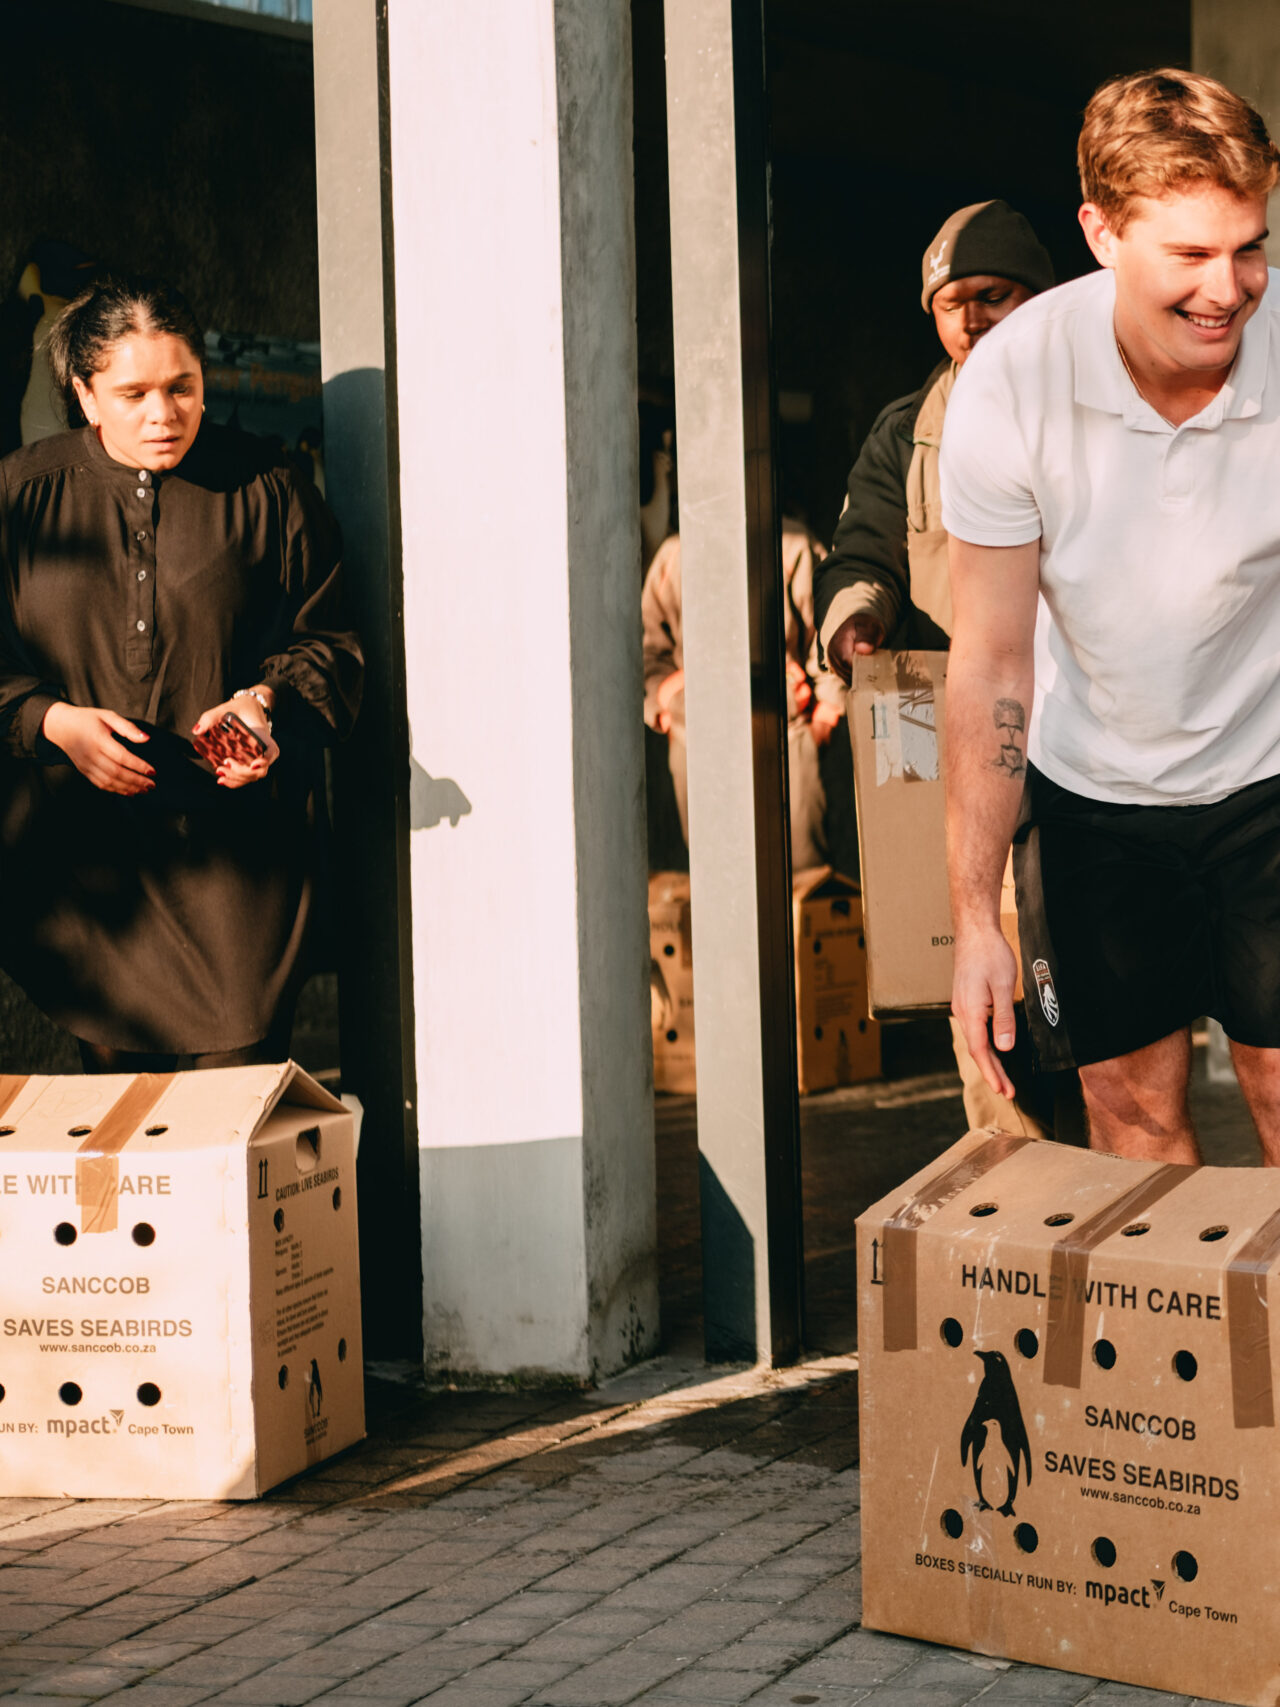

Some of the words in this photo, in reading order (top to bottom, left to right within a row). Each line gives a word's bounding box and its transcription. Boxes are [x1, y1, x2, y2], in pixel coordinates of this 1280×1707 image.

[931, 935, 955, 947] BOX
[118, 1174, 172, 1195] ARE
[42, 1276, 150, 1294] SANCCOB
[1073, 1278, 1137, 1309] WITH
[1147, 1287, 1222, 1320] CARE
[3, 1318, 74, 1337] SAVES
[80, 1319, 193, 1337] SEABIRDS
[39, 1342, 157, 1353] www.sanccob.co.za
[0, 1422, 15, 1433] UN
[18, 1422, 38, 1434] BY:
[47, 1416, 111, 1438] mpact
[128, 1423, 160, 1437] Cape
[161, 1423, 194, 1435] Town
[1085, 1405, 1196, 1441] SANCCOB
[1044, 1451, 1116, 1482] SAVES
[1123, 1463, 1240, 1501] SEABIRDS
[1080, 1487, 1201, 1515] www.sanccob.co.za
[915, 1553, 955, 1573] BOXES
[958, 1562, 1023, 1585] SPECIALLY
[1027, 1575, 1053, 1590] RUN
[1056, 1580, 1077, 1595] BY:
[1085, 1580, 1150, 1608] mpact
[1169, 1600, 1201, 1618] Cape
[1204, 1606, 1238, 1624] Town
